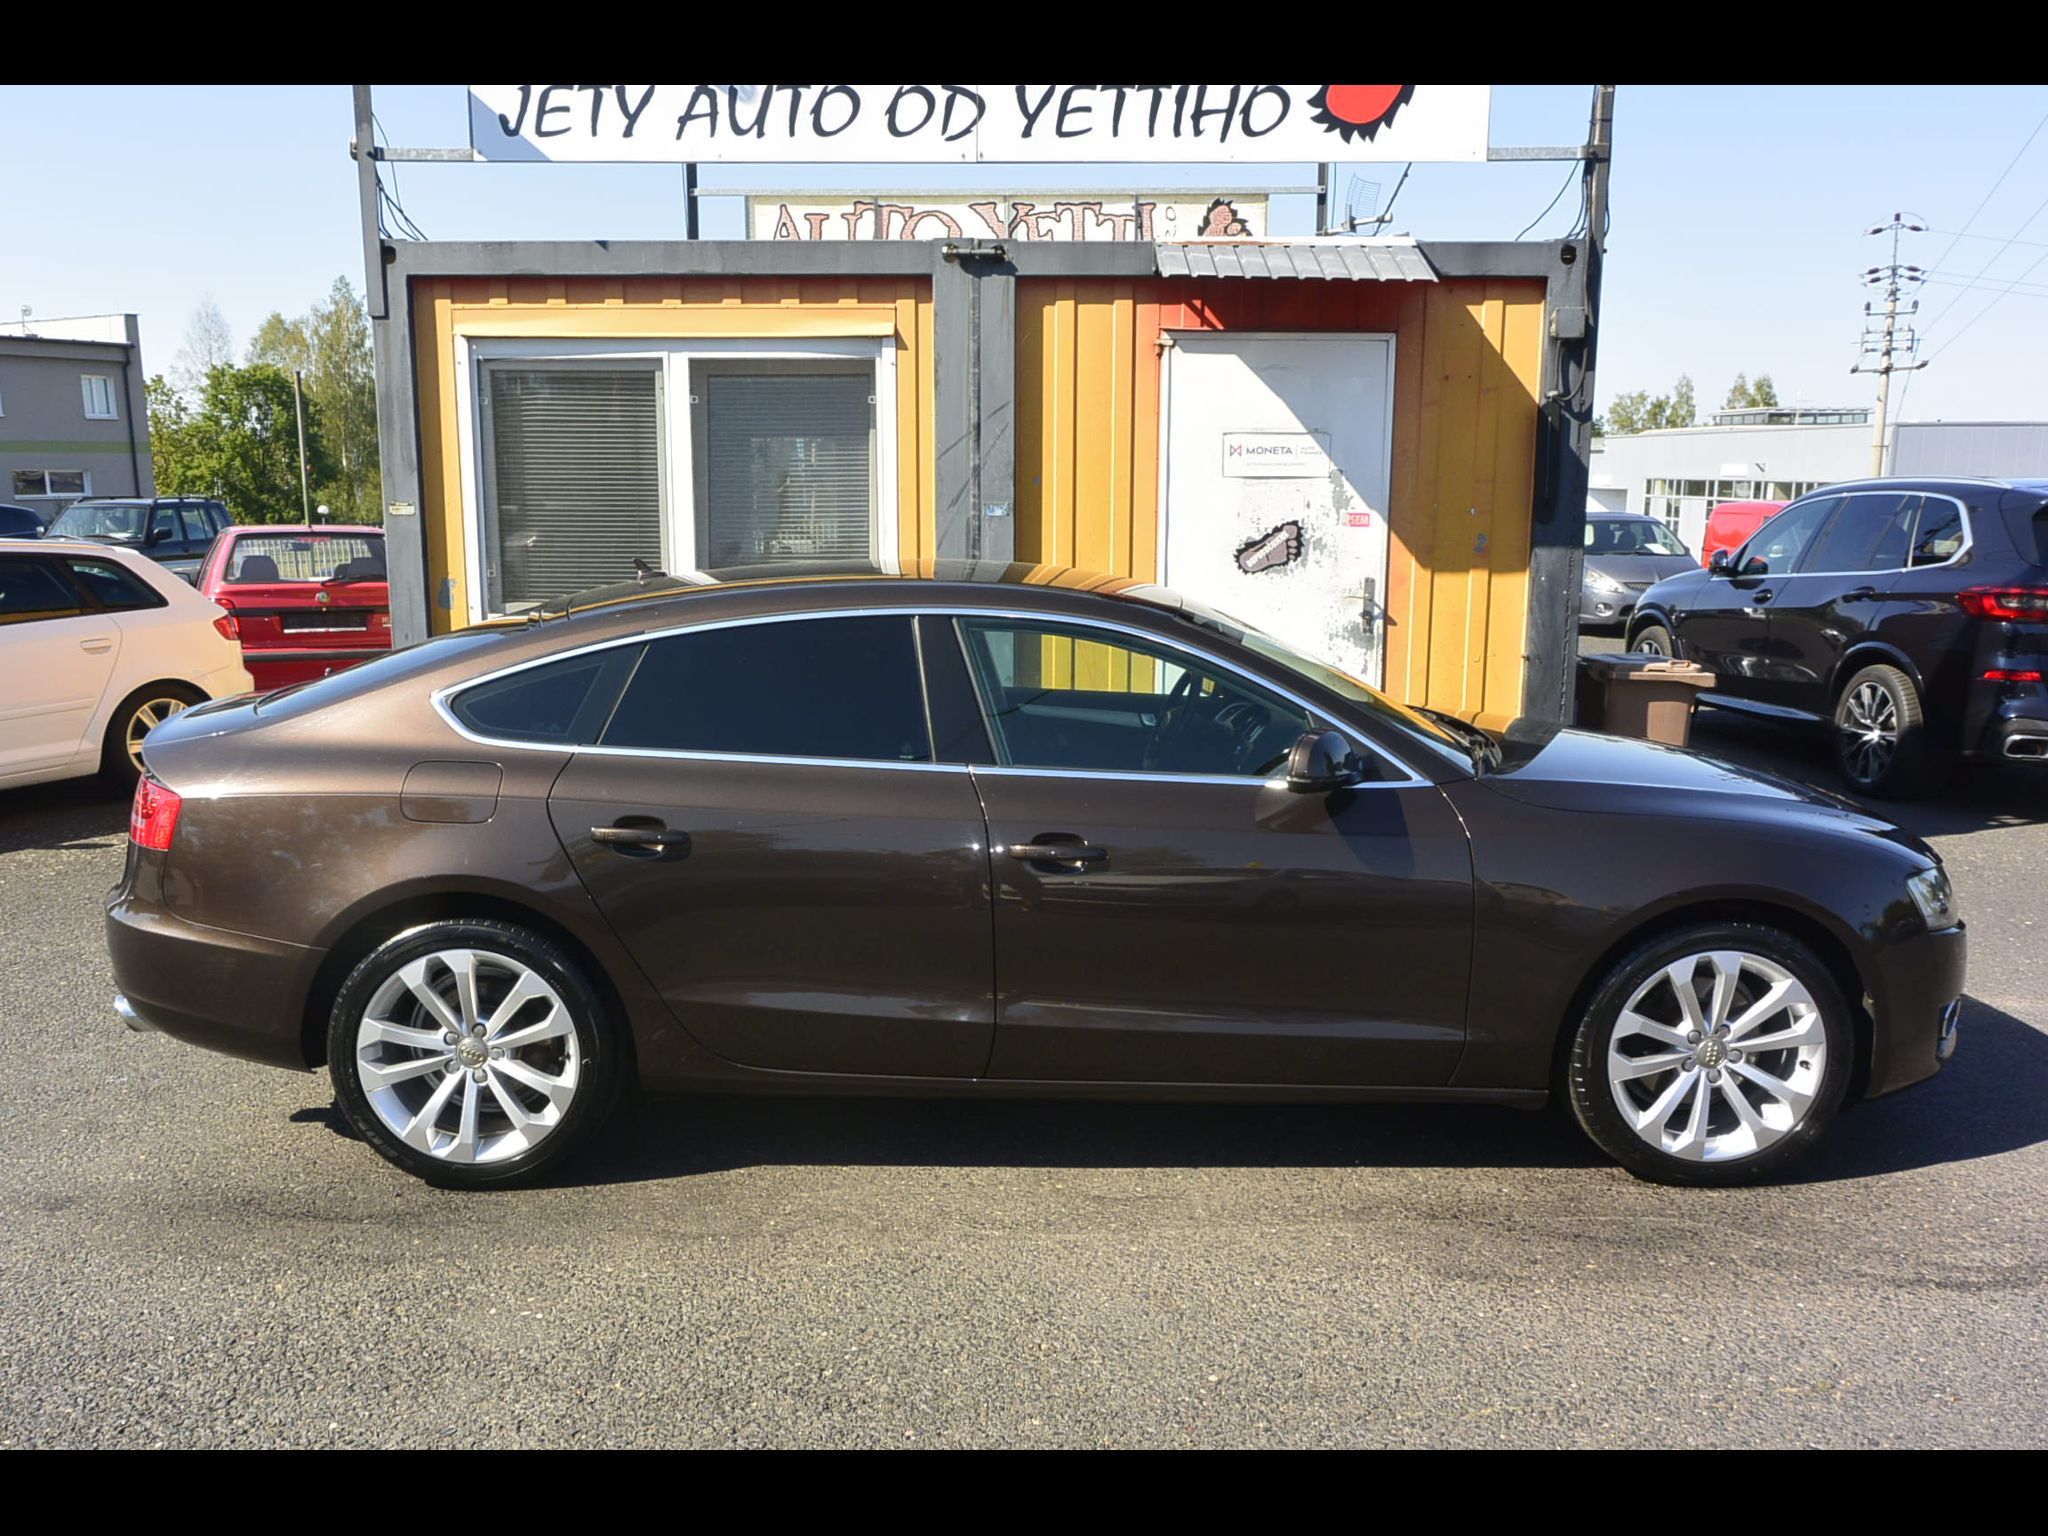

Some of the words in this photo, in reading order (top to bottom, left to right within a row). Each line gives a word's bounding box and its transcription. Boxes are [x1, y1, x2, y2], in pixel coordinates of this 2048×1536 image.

[675, 85, 863, 140] AUTO
[885, 85, 987, 142] OD
[1014, 85, 1291, 143] YETTIHO
[1246, 446, 1294, 456] MONETA
